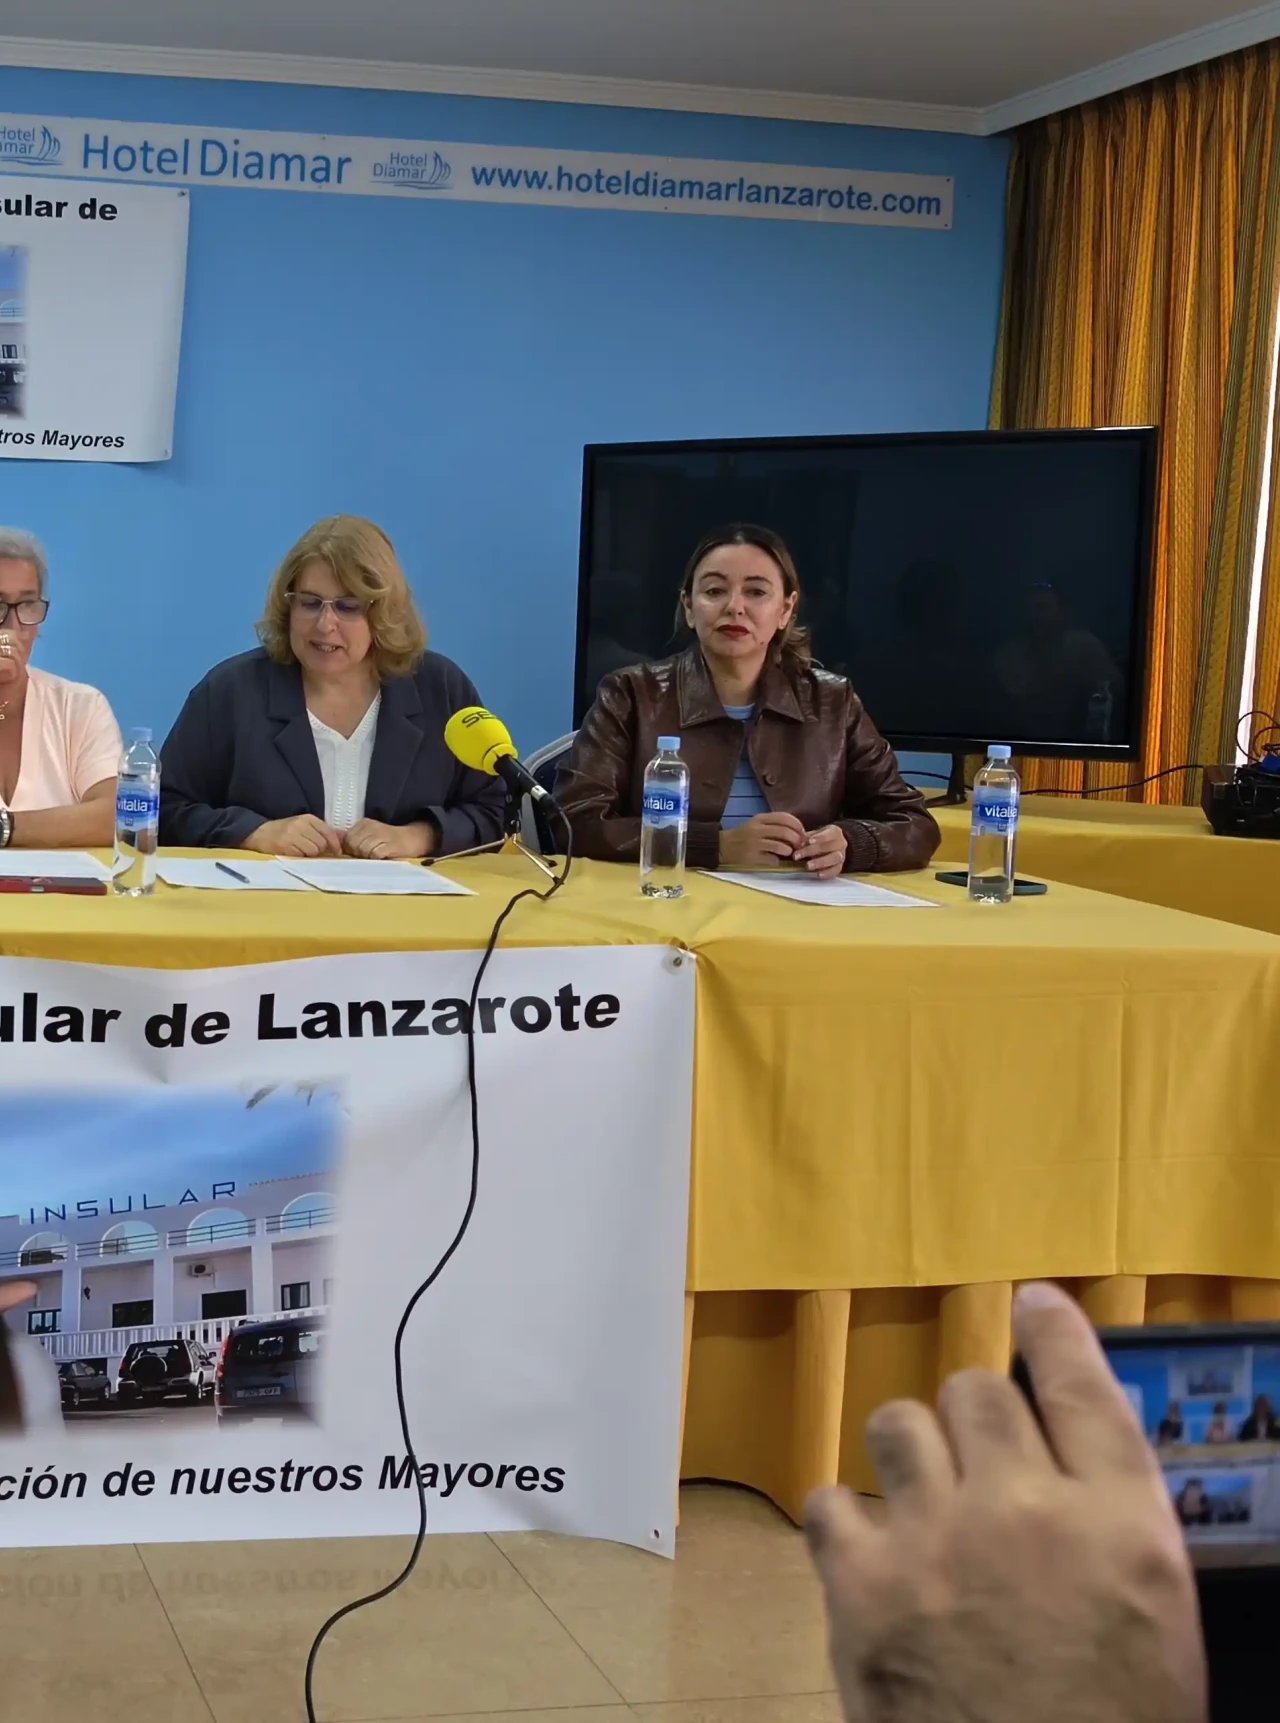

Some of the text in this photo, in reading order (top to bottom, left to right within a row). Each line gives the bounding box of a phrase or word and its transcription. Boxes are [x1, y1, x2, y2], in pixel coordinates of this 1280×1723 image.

[83, 133, 353, 184] Hotel Diamar
[373, 162, 427, 179] Diamar
[390, 152, 427, 167] Hotel
[471, 164, 941, 216] www.hoteldiamarlanzarote.com
[78, 197, 118, 221] de
[41, 430, 126, 450] Mayores
[462, 711, 497, 728] SE
[984, 804, 1018, 818] vitalia
[144, 1003, 231, 1049] de
[257, 984, 621, 1042] Lanzarote
[30, 1181, 236, 1225] INSULAR
[102, 1462, 156, 1498] de
[169, 1457, 364, 1495] nuestros
[378, 1454, 566, 1495] Mayores
